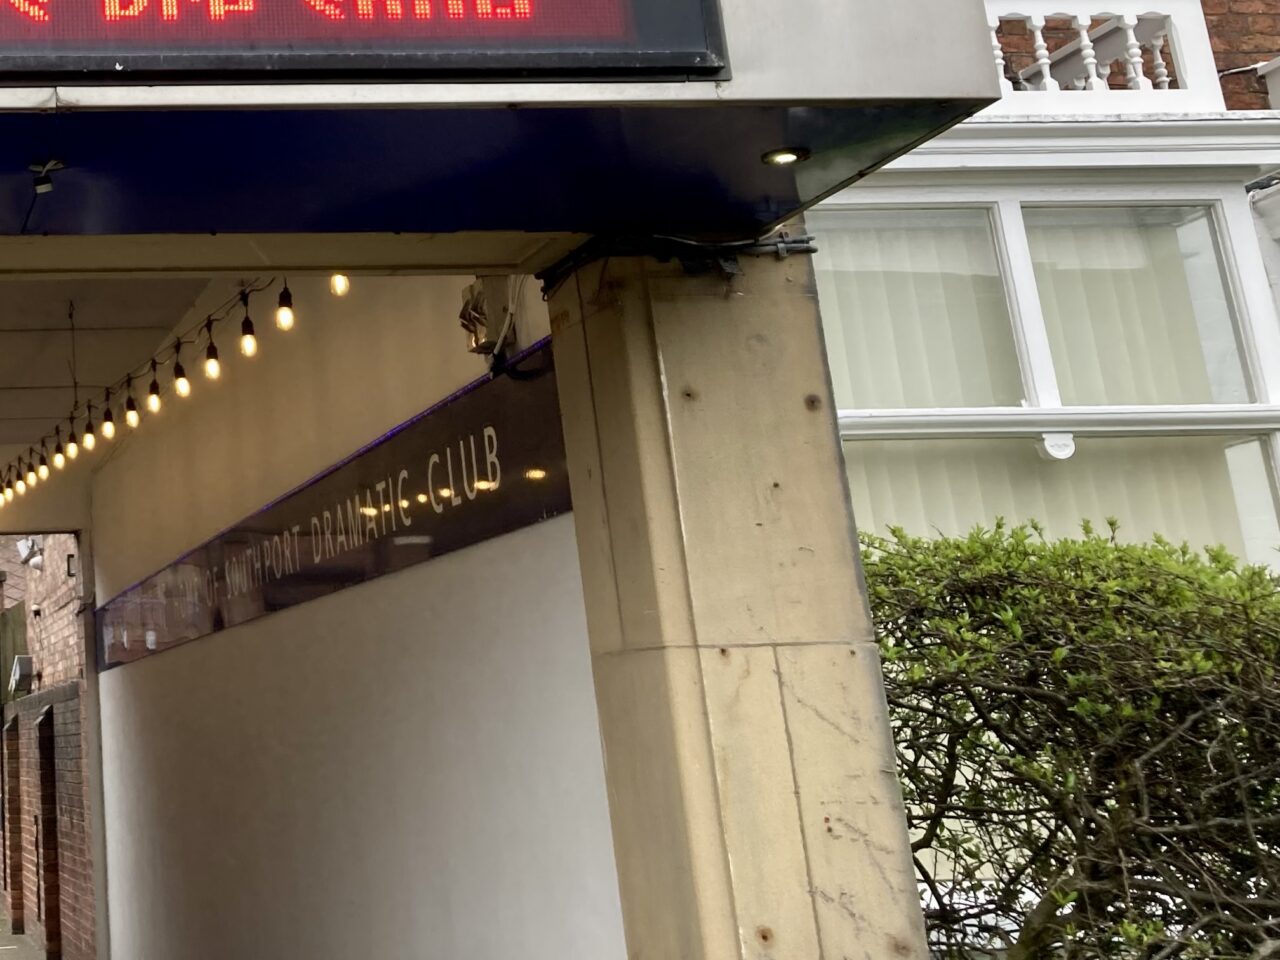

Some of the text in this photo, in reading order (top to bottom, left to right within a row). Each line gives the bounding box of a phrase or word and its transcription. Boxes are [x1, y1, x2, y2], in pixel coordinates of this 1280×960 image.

[225, 525, 301, 600] SOUTHPORT
[311, 469, 411, 564] DRAMATIC
[428, 426, 501, 514] CLUB
